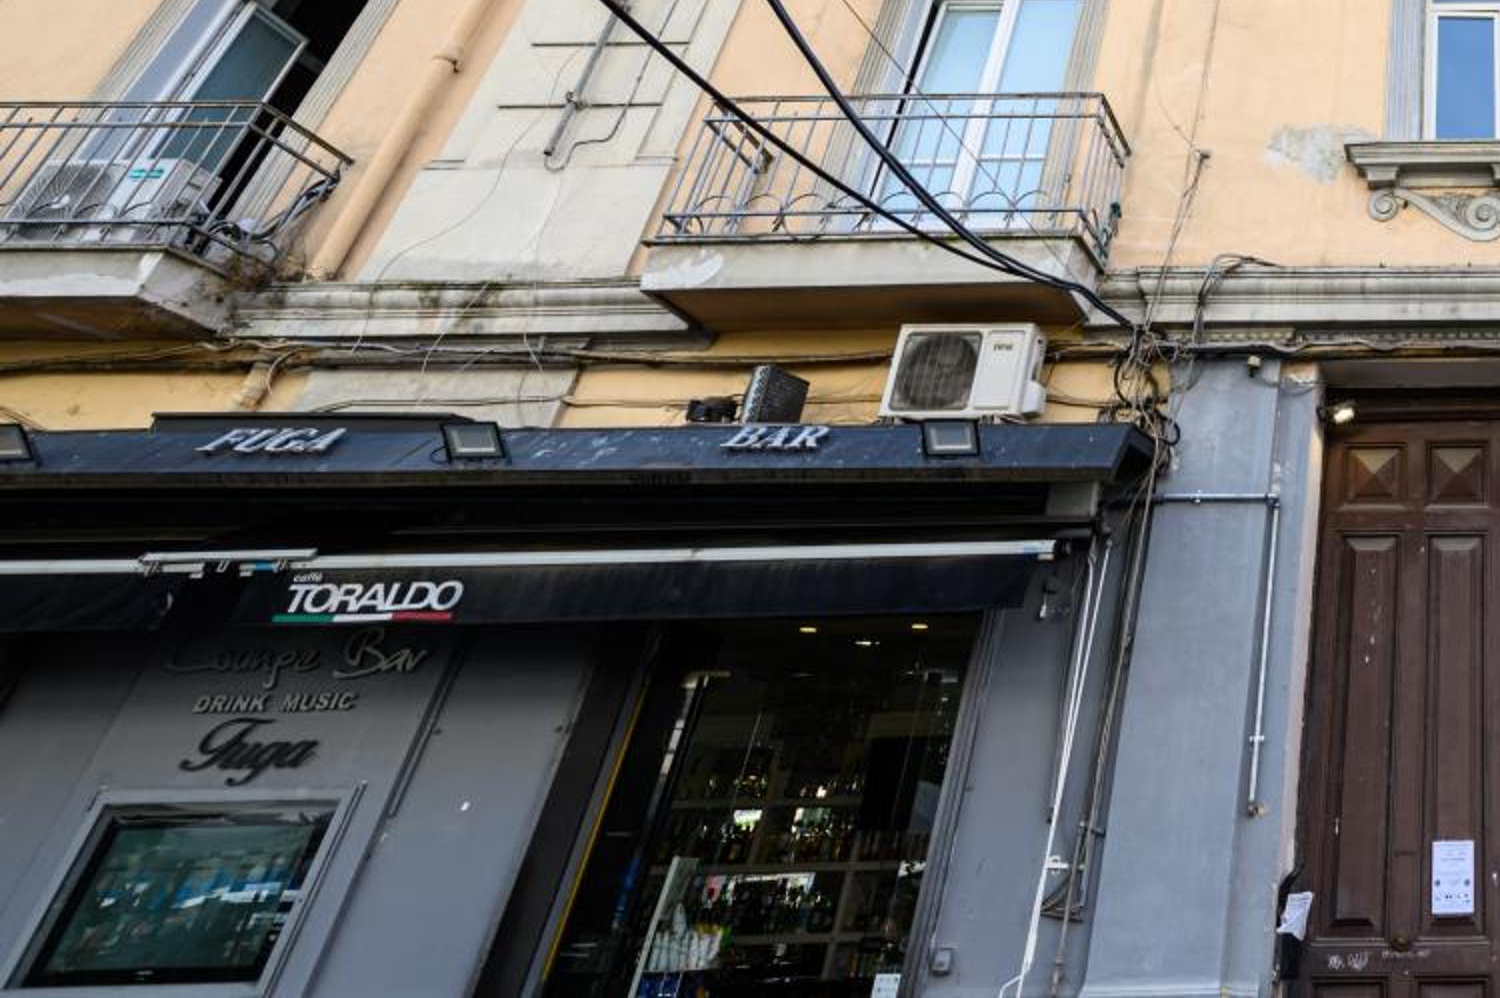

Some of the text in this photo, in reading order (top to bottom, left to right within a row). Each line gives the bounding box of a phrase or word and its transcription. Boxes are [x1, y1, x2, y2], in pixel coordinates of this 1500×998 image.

[195, 427, 347, 452] FUGA
[719, 425, 832, 448] BAR
[287, 580, 464, 614] TORALDO
[332, 625, 428, 679] Bar
[191, 692, 358, 714] DRINK MUSIC
